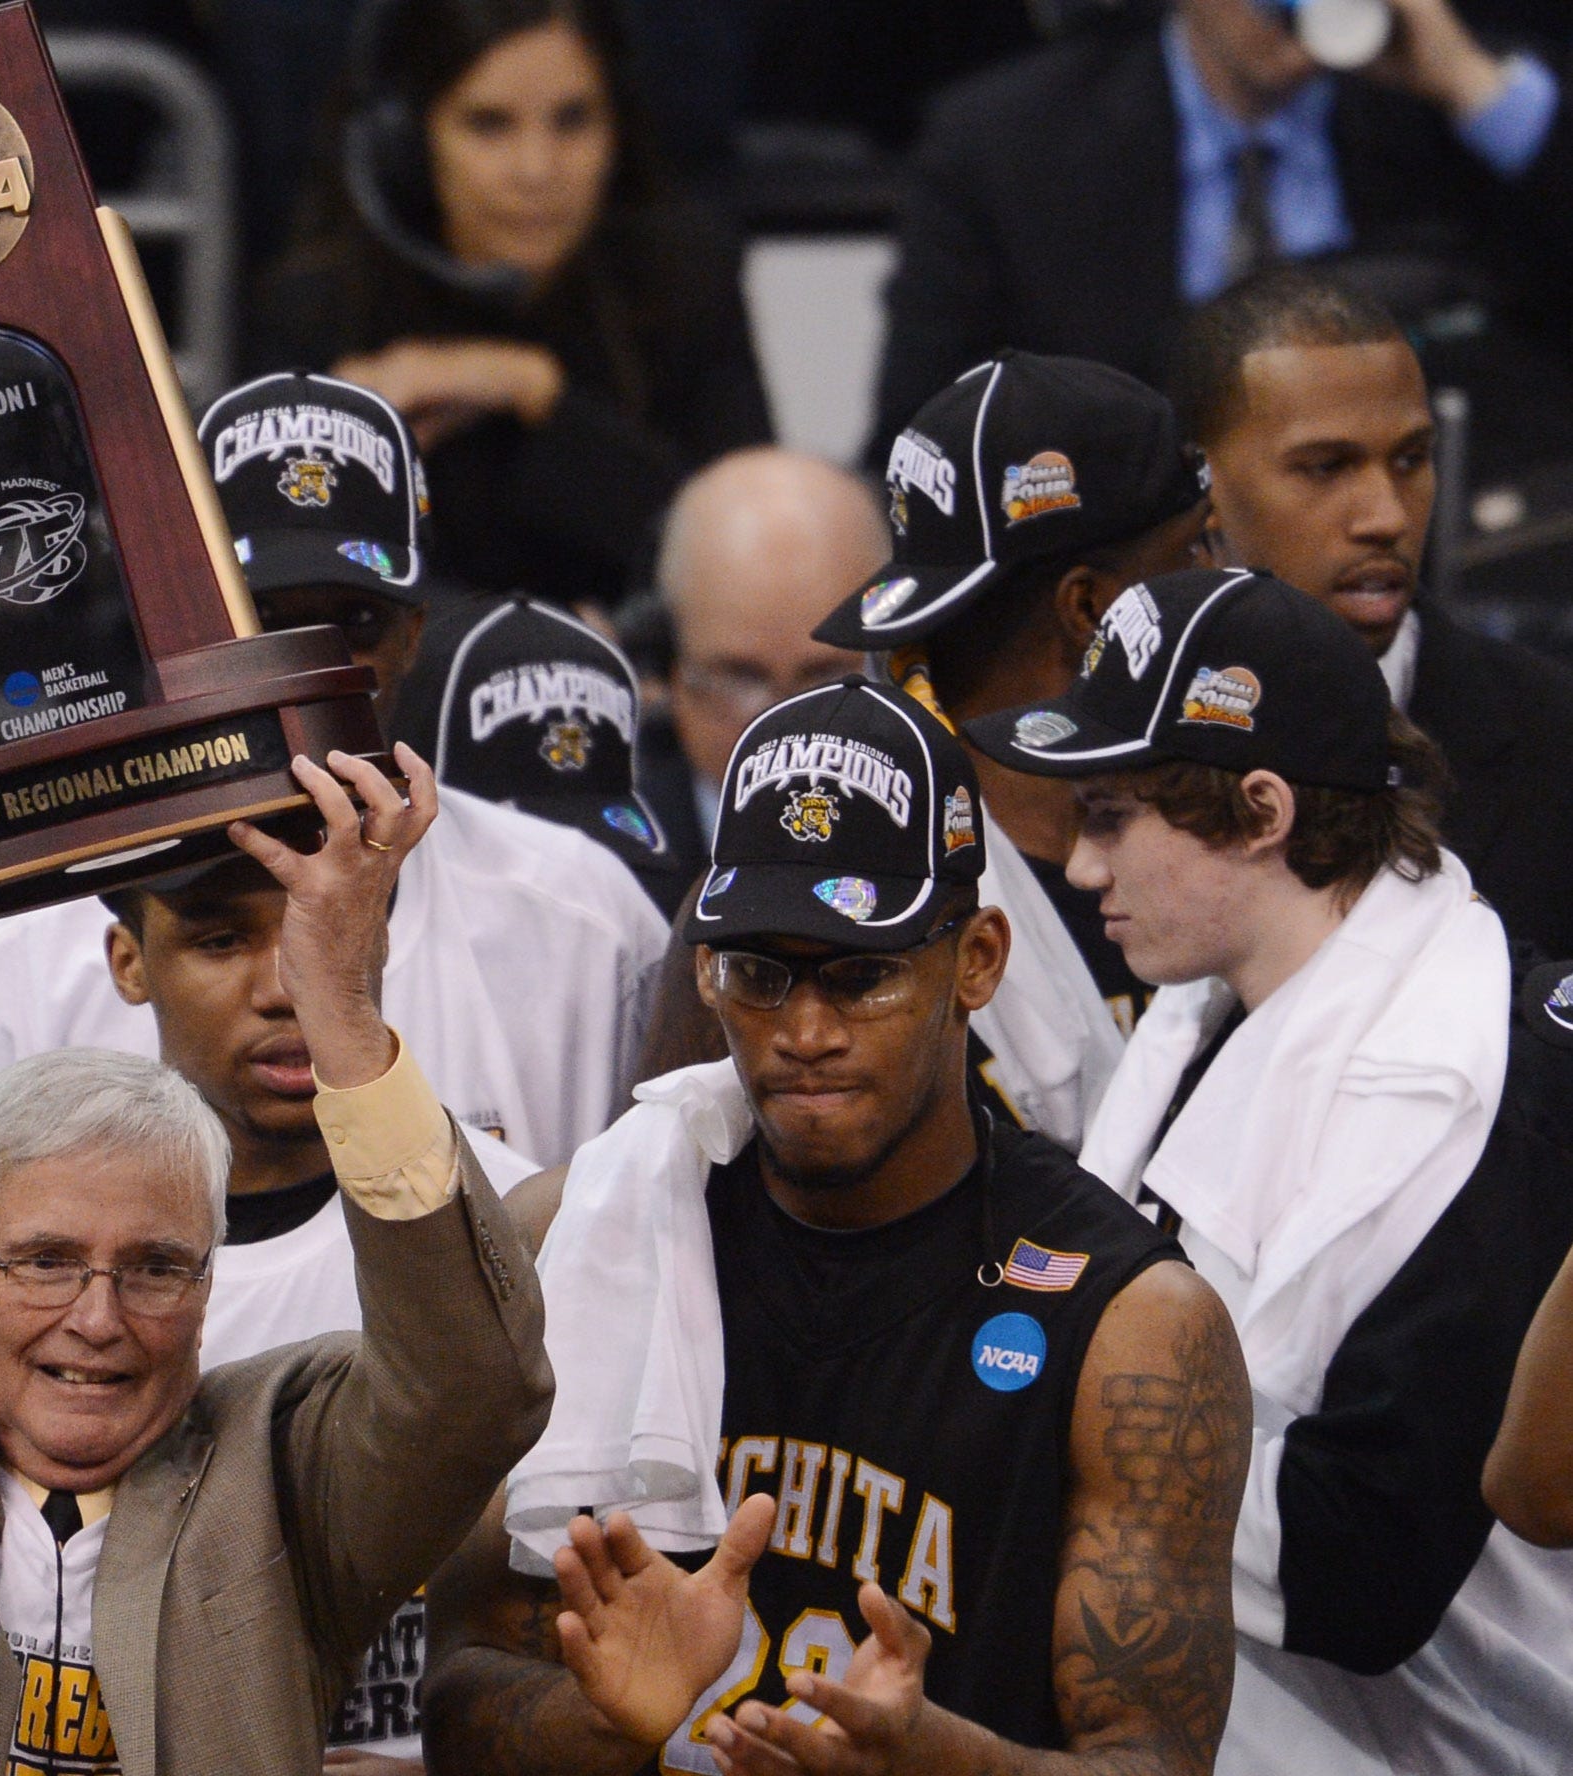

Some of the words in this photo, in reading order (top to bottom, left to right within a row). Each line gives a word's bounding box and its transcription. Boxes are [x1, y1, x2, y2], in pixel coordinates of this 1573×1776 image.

[25, 381, 38, 407] I
[214, 411, 395, 495] CHAMPIONS
[41, 662, 76, 684] MEN'S
[44, 670, 109, 698] BASKETBALL
[0, 691, 127, 741] CHAMPIONSHIP
[781, 733, 807, 745] NCAA
[846, 738, 896, 768] REGIONAL
[4, 764, 123, 821] REGIONAL
[123, 732, 251, 788] CHAMPION
[734, 741, 913, 829] CHAMPIONS
[978, 1344, 1039, 1376] NCAA
[717, 1434, 957, 1635] CHITA
[15, 1652, 119, 1761] REG
